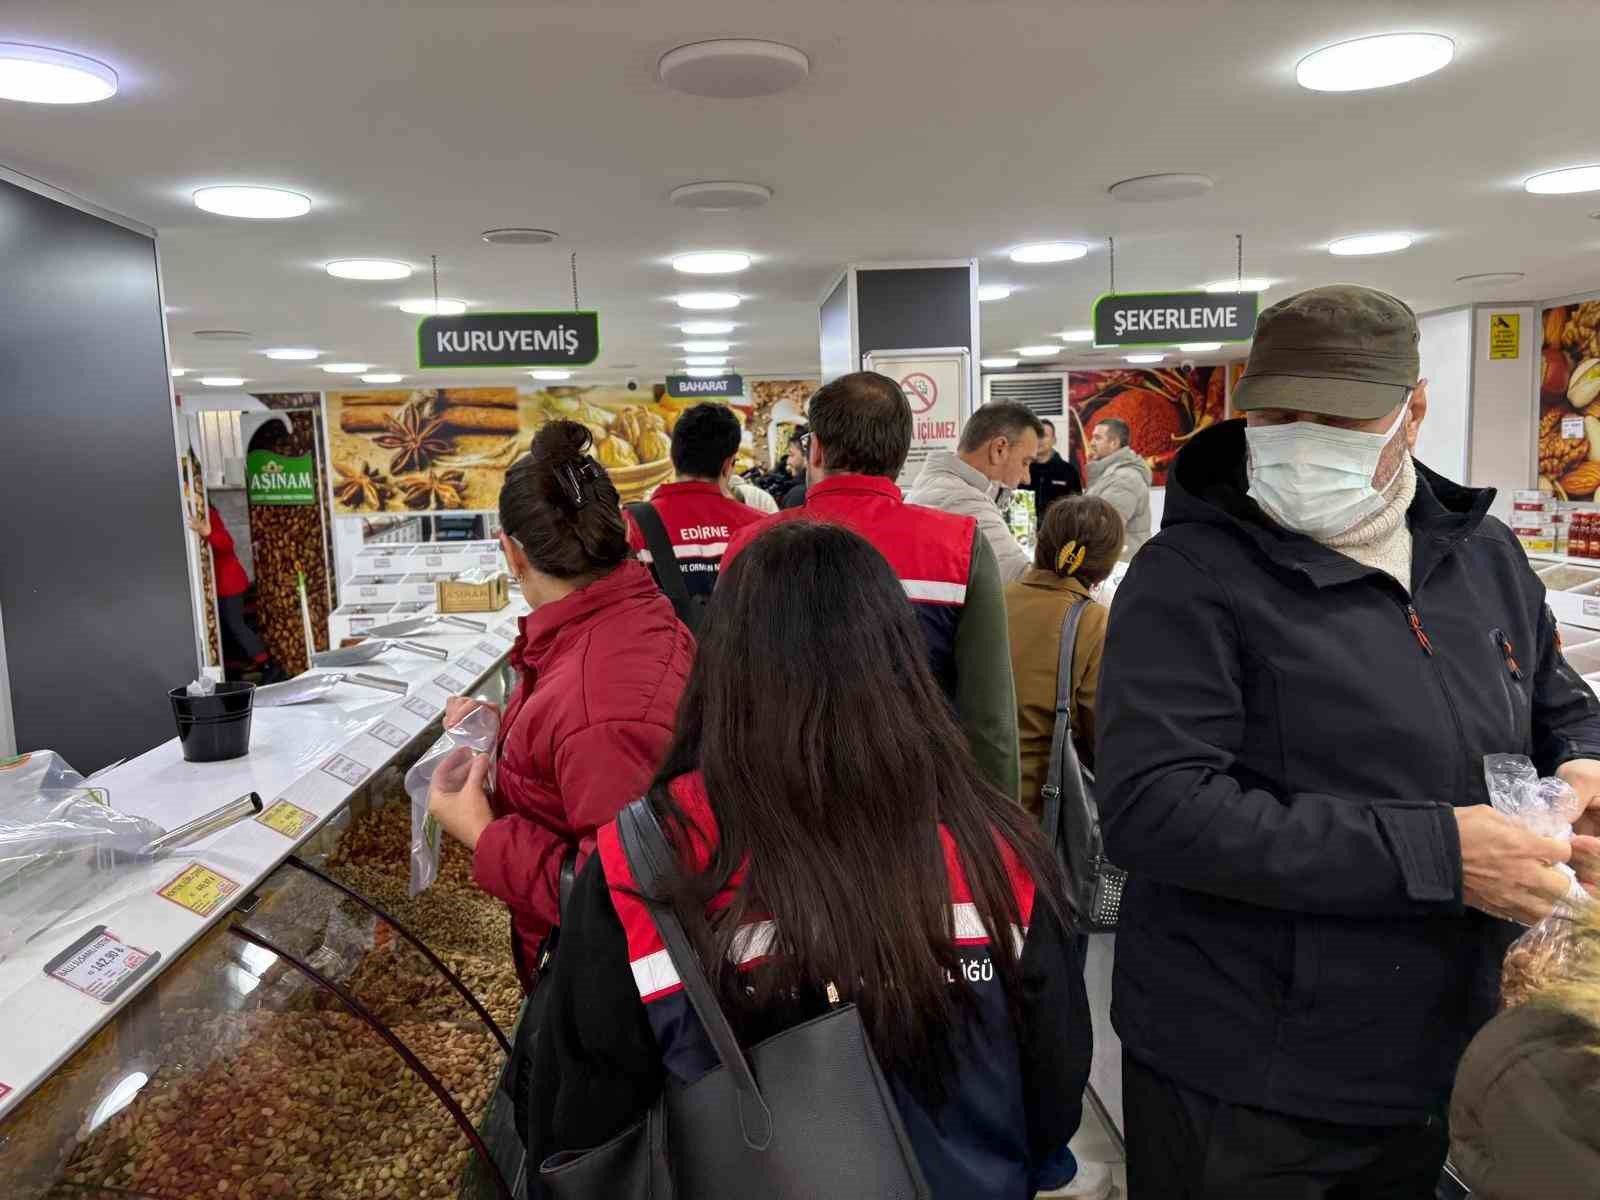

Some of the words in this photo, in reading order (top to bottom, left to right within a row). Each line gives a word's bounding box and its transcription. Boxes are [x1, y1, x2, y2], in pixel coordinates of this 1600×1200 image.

[1114, 307, 1238, 336] ŞEKERLEME
[436, 324, 580, 355] KURUYEMİŞ
[679, 380, 729, 393] BAHARAT
[917, 417, 957, 445] İÇİLMEZ
[251, 472, 312, 493] AŞINAM
[680, 525, 730, 541] EDİRNE
